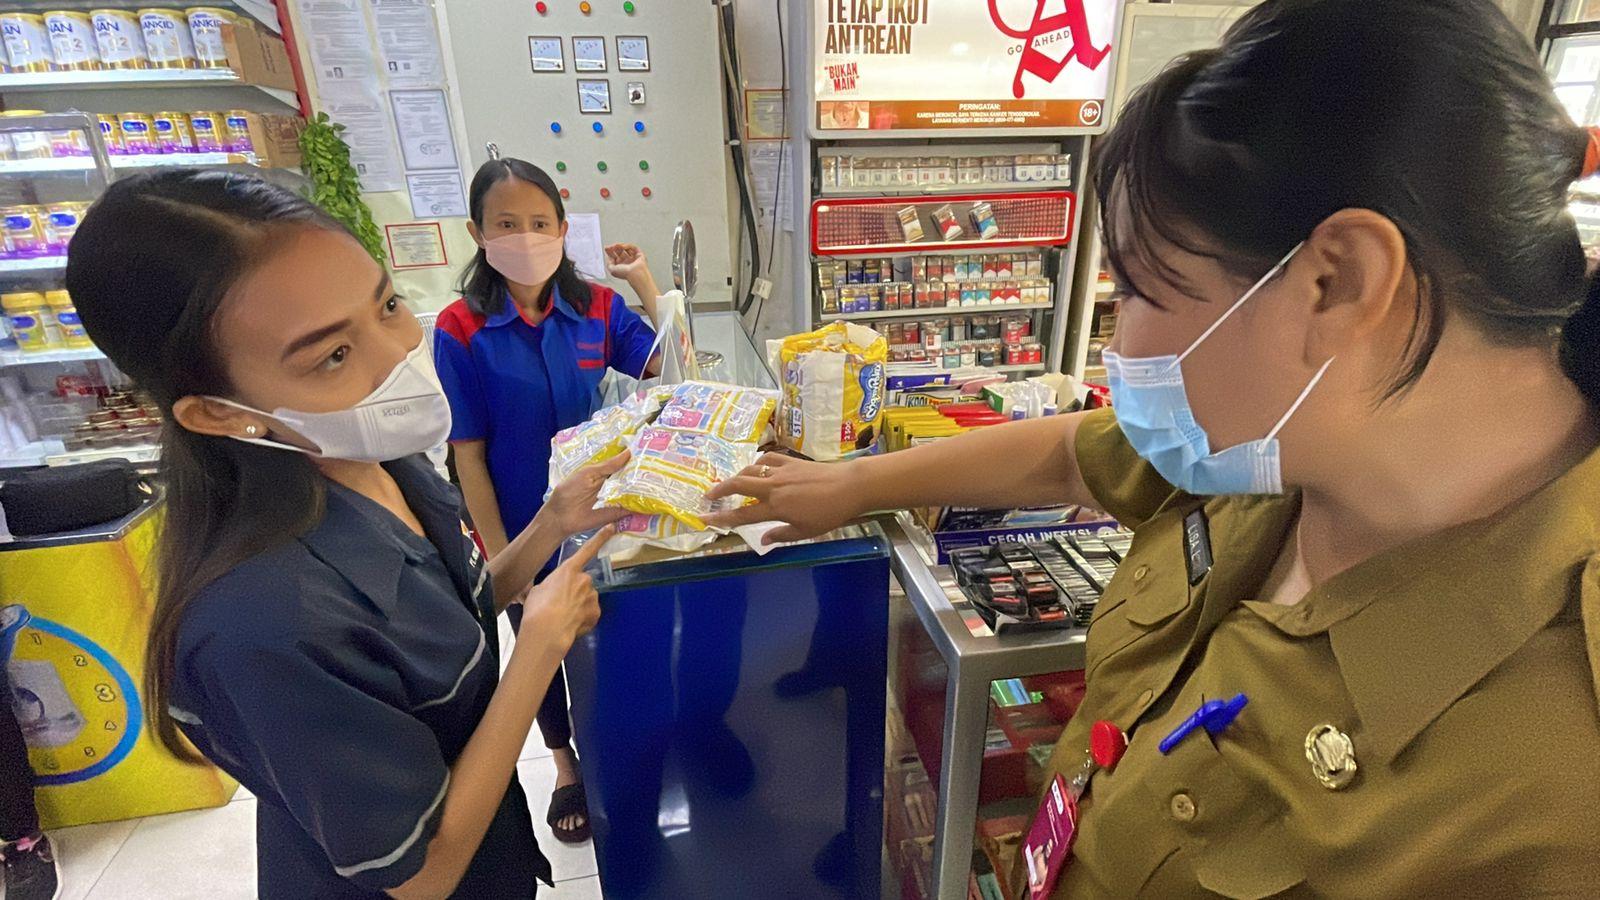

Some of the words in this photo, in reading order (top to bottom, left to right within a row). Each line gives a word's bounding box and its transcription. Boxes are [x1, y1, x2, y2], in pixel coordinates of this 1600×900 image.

[825, 24, 912, 54] ANTREAN
[1007, 44, 1022, 55] GO
[1034, 30, 1070, 47] AHEAD
[1083, 108, 1098, 118] 18+
[988, 533, 1036, 545] CEGAH
[73, 654, 88, 667] 2
[94, 683, 116, 702] 3
[104, 720, 117, 731] 4
